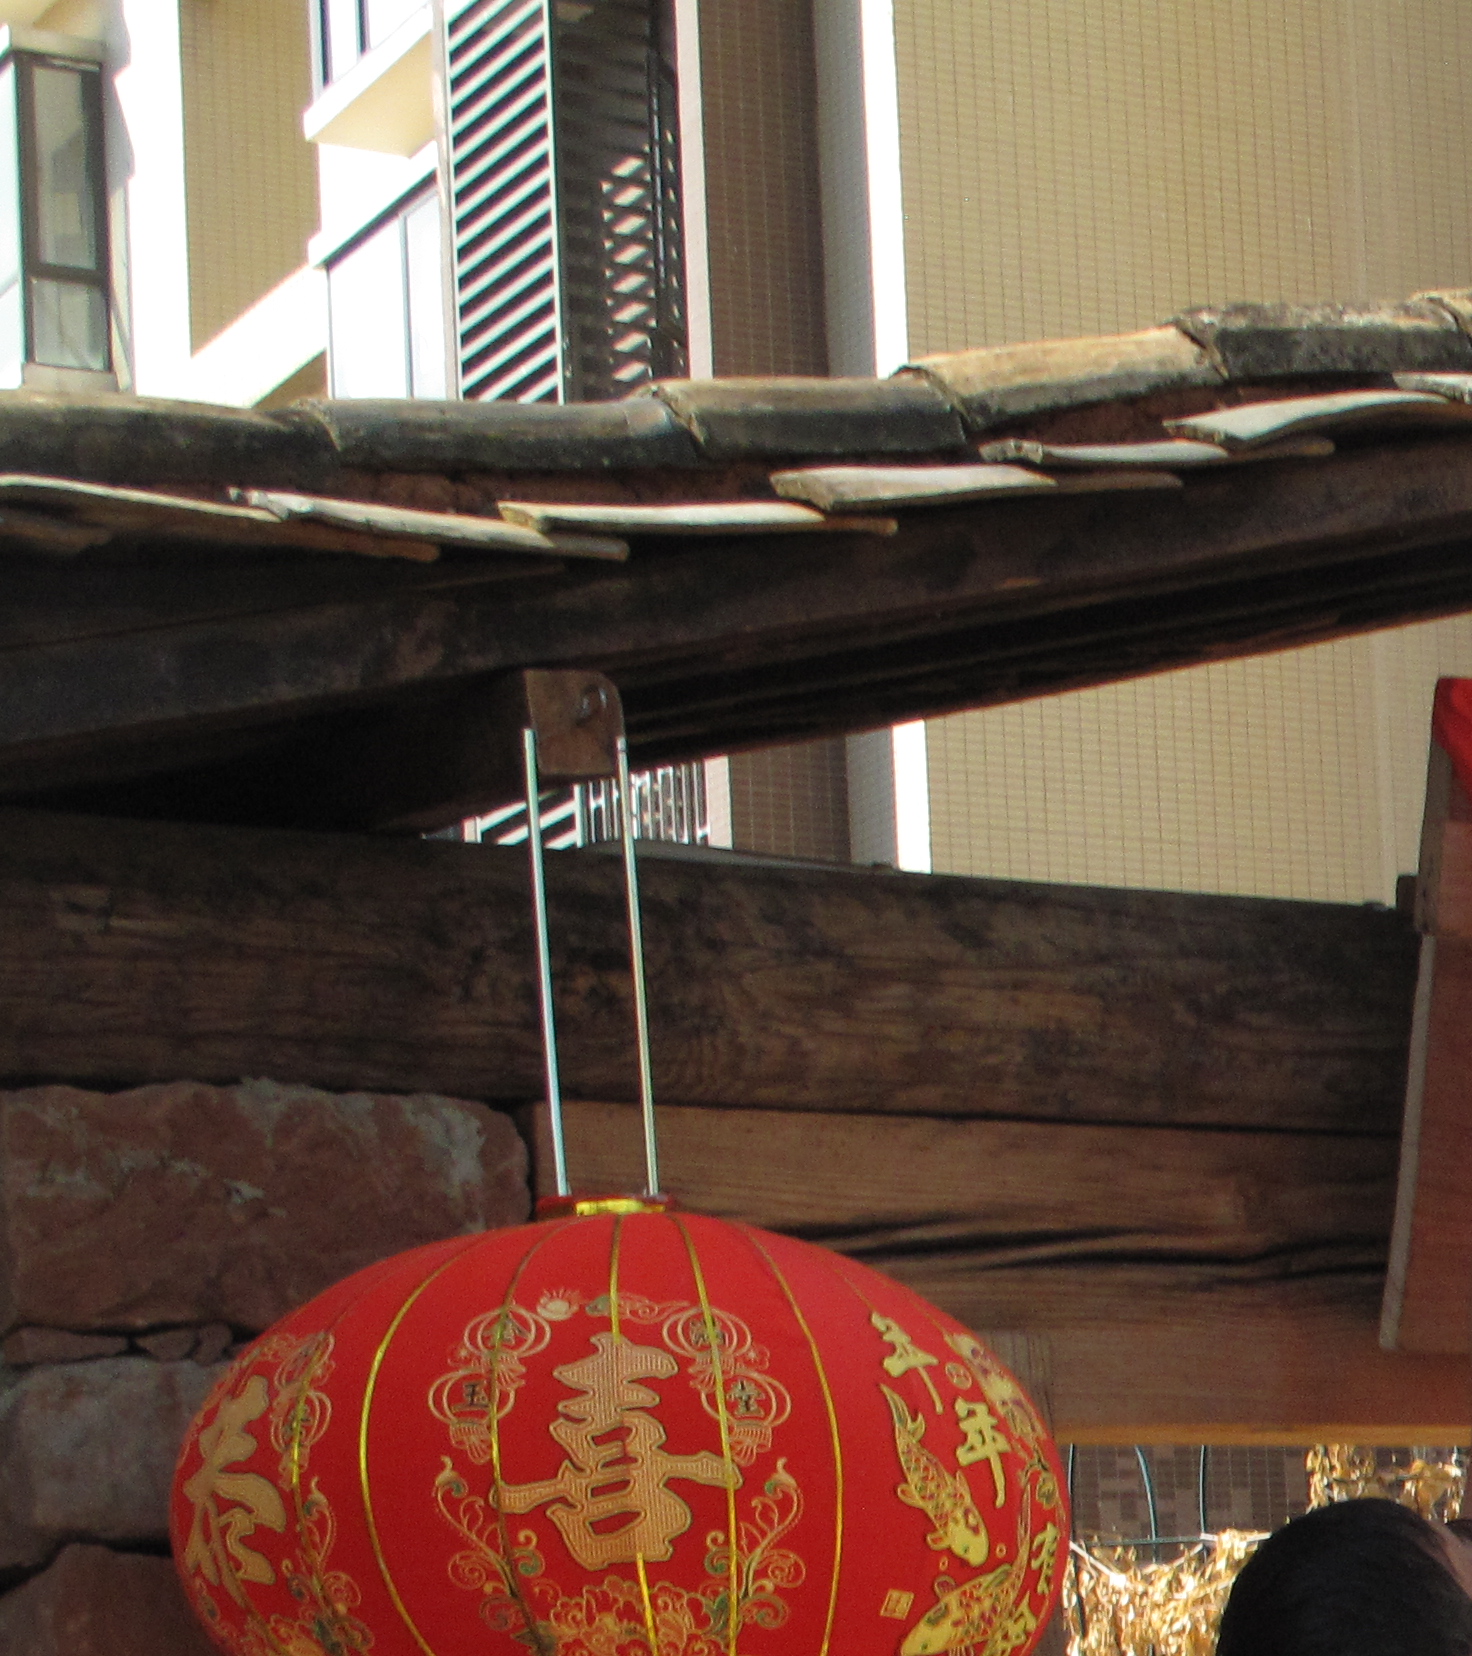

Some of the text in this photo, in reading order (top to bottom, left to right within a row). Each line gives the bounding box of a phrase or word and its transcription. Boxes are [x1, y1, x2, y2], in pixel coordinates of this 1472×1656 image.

[871, 1310, 939, 1414] 年
[489, 1333, 743, 1570] 喜
[954, 1396, 1011, 1508] 年
